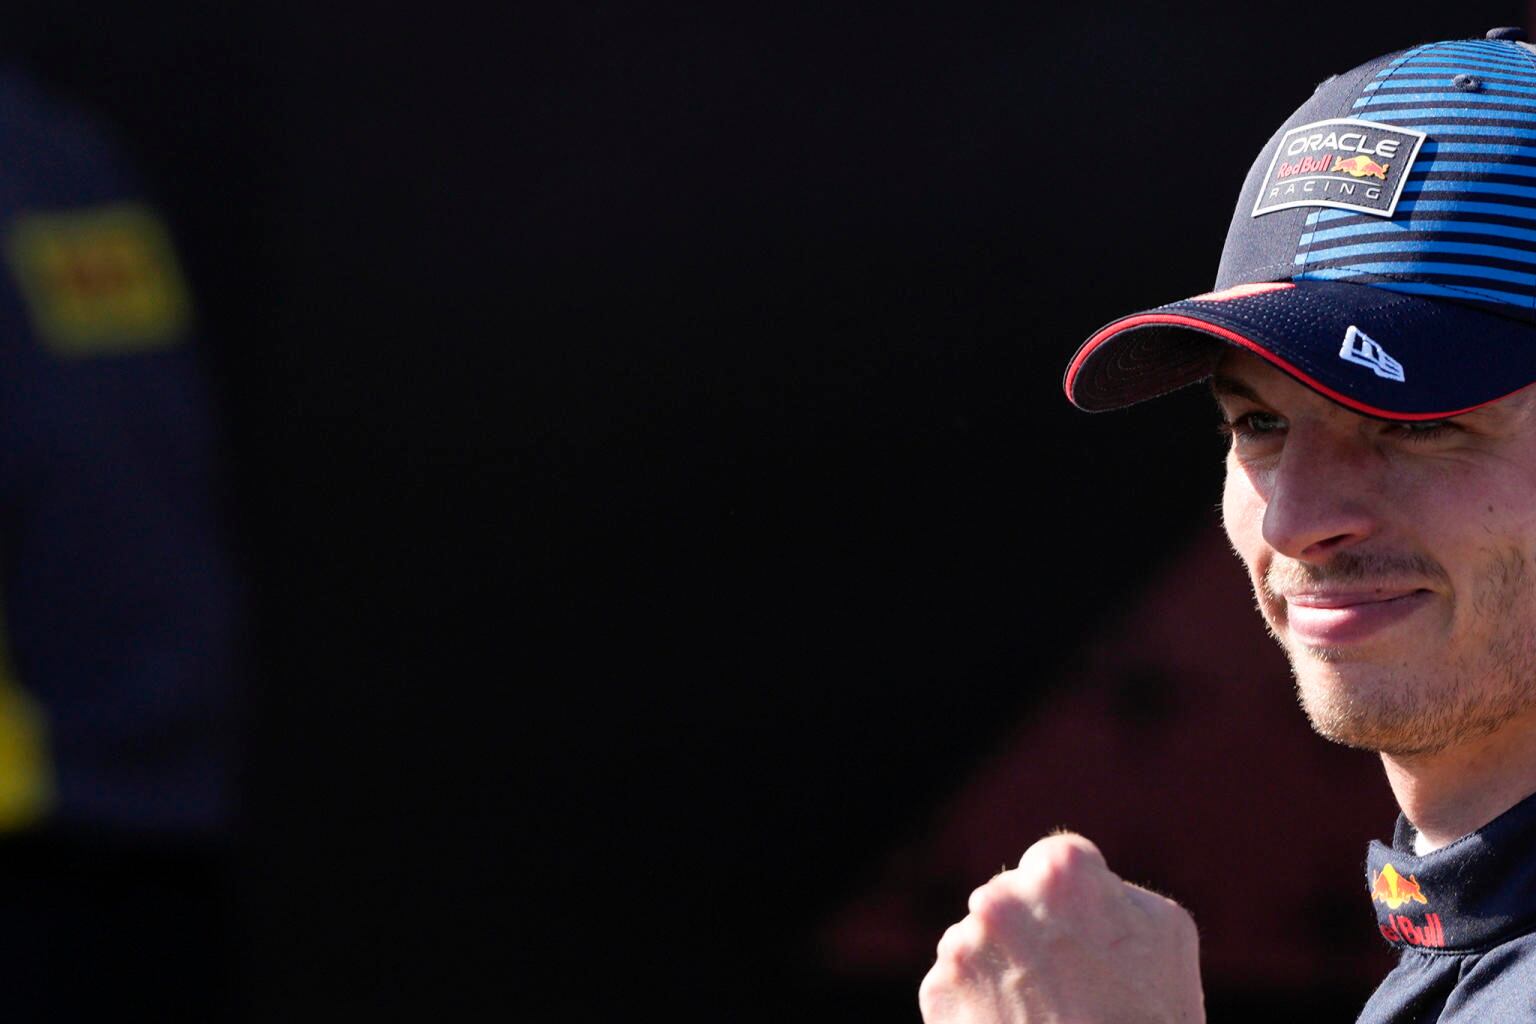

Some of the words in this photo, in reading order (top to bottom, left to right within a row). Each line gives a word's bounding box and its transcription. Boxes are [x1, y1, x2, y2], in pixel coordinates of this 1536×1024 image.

[1287, 131, 1400, 159] ORACLE
[1268, 180, 1382, 200] RACING
[1379, 912, 1400, 942] ed
